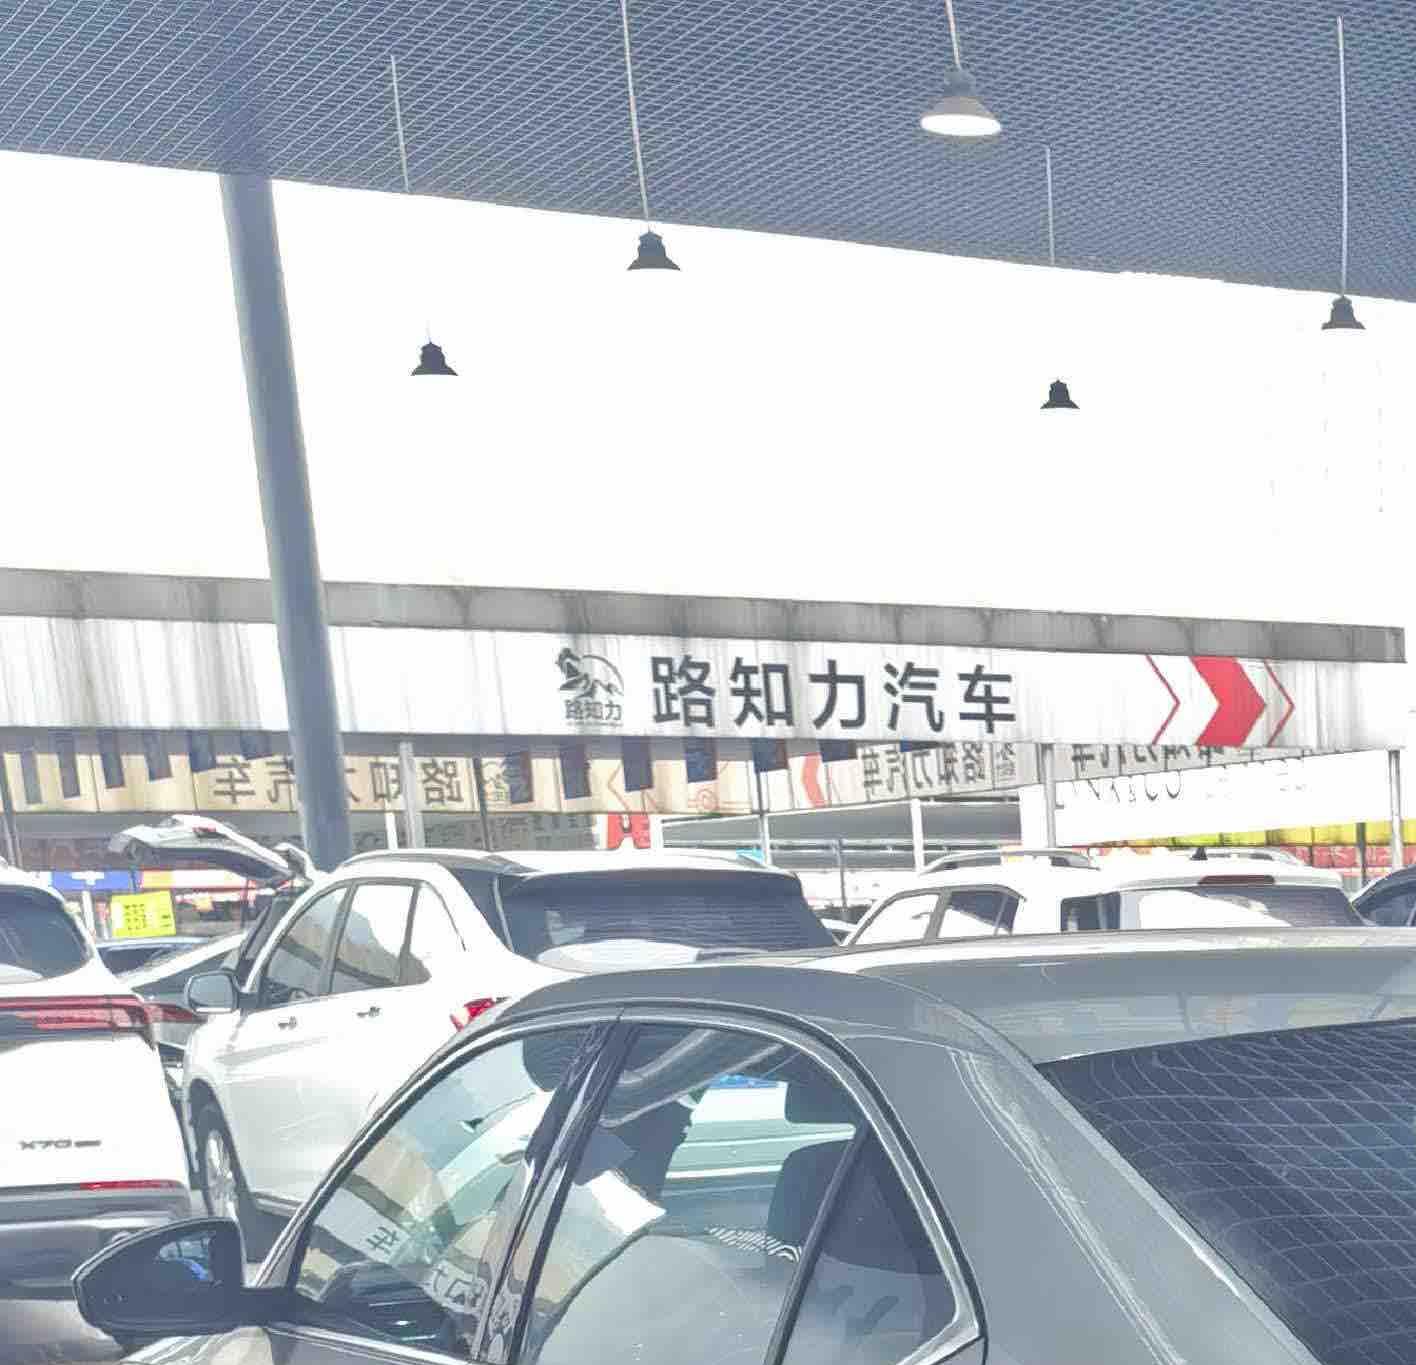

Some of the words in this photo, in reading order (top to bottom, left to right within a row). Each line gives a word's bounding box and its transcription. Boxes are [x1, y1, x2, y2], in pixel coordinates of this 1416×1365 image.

[650, 654, 1016, 734] 路知力汽车
